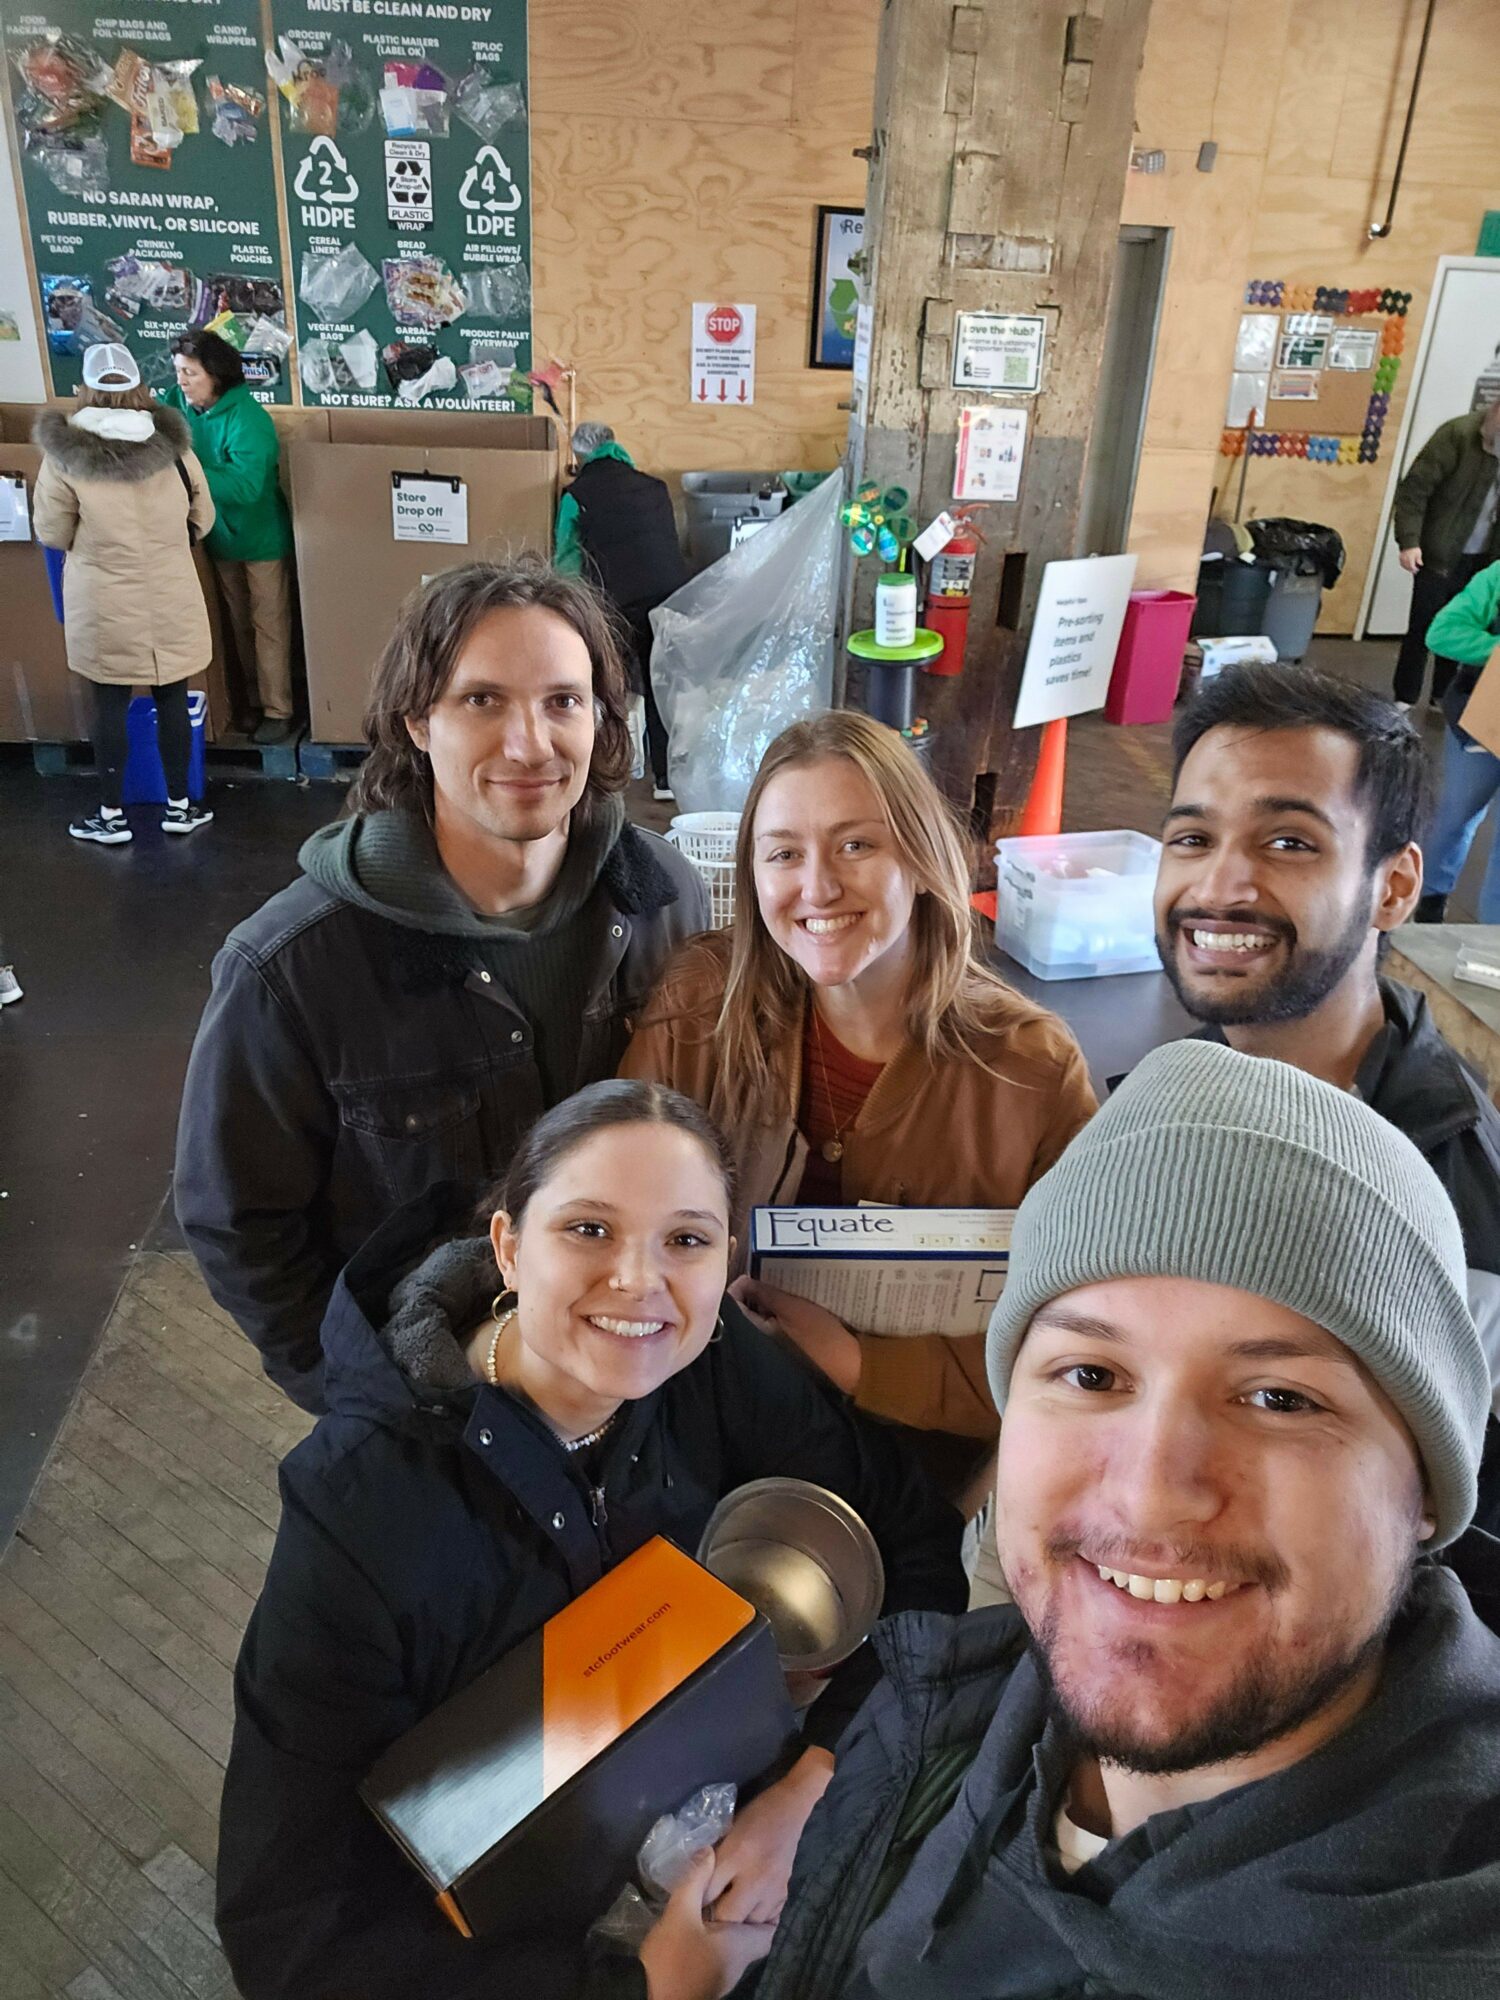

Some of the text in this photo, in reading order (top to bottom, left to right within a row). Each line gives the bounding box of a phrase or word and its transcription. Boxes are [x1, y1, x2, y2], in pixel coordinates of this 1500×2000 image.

[307, 0, 492, 22] MUST BE CLEAN AND DRY
[95, 18, 168, 31] CHIP BAGS AND
[213, 25, 248, 36] CANDY
[93, 29, 171, 42] FOIL-LINED BAGS
[206, 35, 257, 47] WRAPPERS
[288, 29, 332, 41] GROCERY
[363, 34, 440, 48] PLASTIC MAILERS
[298, 40, 324, 51] BAGS
[472, 41, 503, 52] ZIPLOC
[475, 51, 501, 62] BAGS
[389, 149, 408, 157] Clean
[415, 150, 426, 159] Dry
[318, 161, 334, 186] 2
[481, 171, 496, 195] 4
[83, 191, 219, 213] NO SARAN WRAP,
[301, 206, 356, 229] HDPE
[391, 210, 430, 220] PLASTIC
[48, 211, 260, 236] RUBBER, VINYL, OR SILICONE
[397, 222, 425, 232] WRAP
[466, 214, 516, 237] LDPE
[41, 234, 83, 246] PET FOOD
[136, 239, 176, 250] CRINKLY
[309, 236, 342, 246] CEREAL
[397, 240, 426, 250] BREAD
[50, 244, 75, 254] BAGS
[129, 248, 183, 260] PACKAGING
[232, 244, 269, 255] PLASTIC
[311, 245, 341, 255] LINERS
[400, 249, 424, 258] BAGS
[464, 243, 480, 253] AIR
[231, 253, 273, 265] POUCHES
[463, 252, 522, 264] BUBBLE WRAP
[143, 320, 188, 331] SIX-PACK
[307, 322, 355, 333] VEGETABLE
[708, 317, 741, 332] STOP
[320, 332, 344, 342] BAGS
[404, 335, 428, 345] BAGS
[460, 329, 530, 341] PRODUCT PALLET
[471, 338, 519, 349] OVERWRAP
[321, 393, 516, 412] NOT SURE? ASK A VOLUNTEER!
[397, 492, 427, 503] Store
[397, 505, 443, 518] Drop Off
[1057, 612, 1104, 628] Pre-sorting
[1078, 631, 1096, 644] and
[1048, 652, 1082, 668] plastics
[1045, 673, 1069, 686] saves
[768, 1212, 895, 1247] Equate
[583, 1602, 671, 1678] stcfootwear.com
